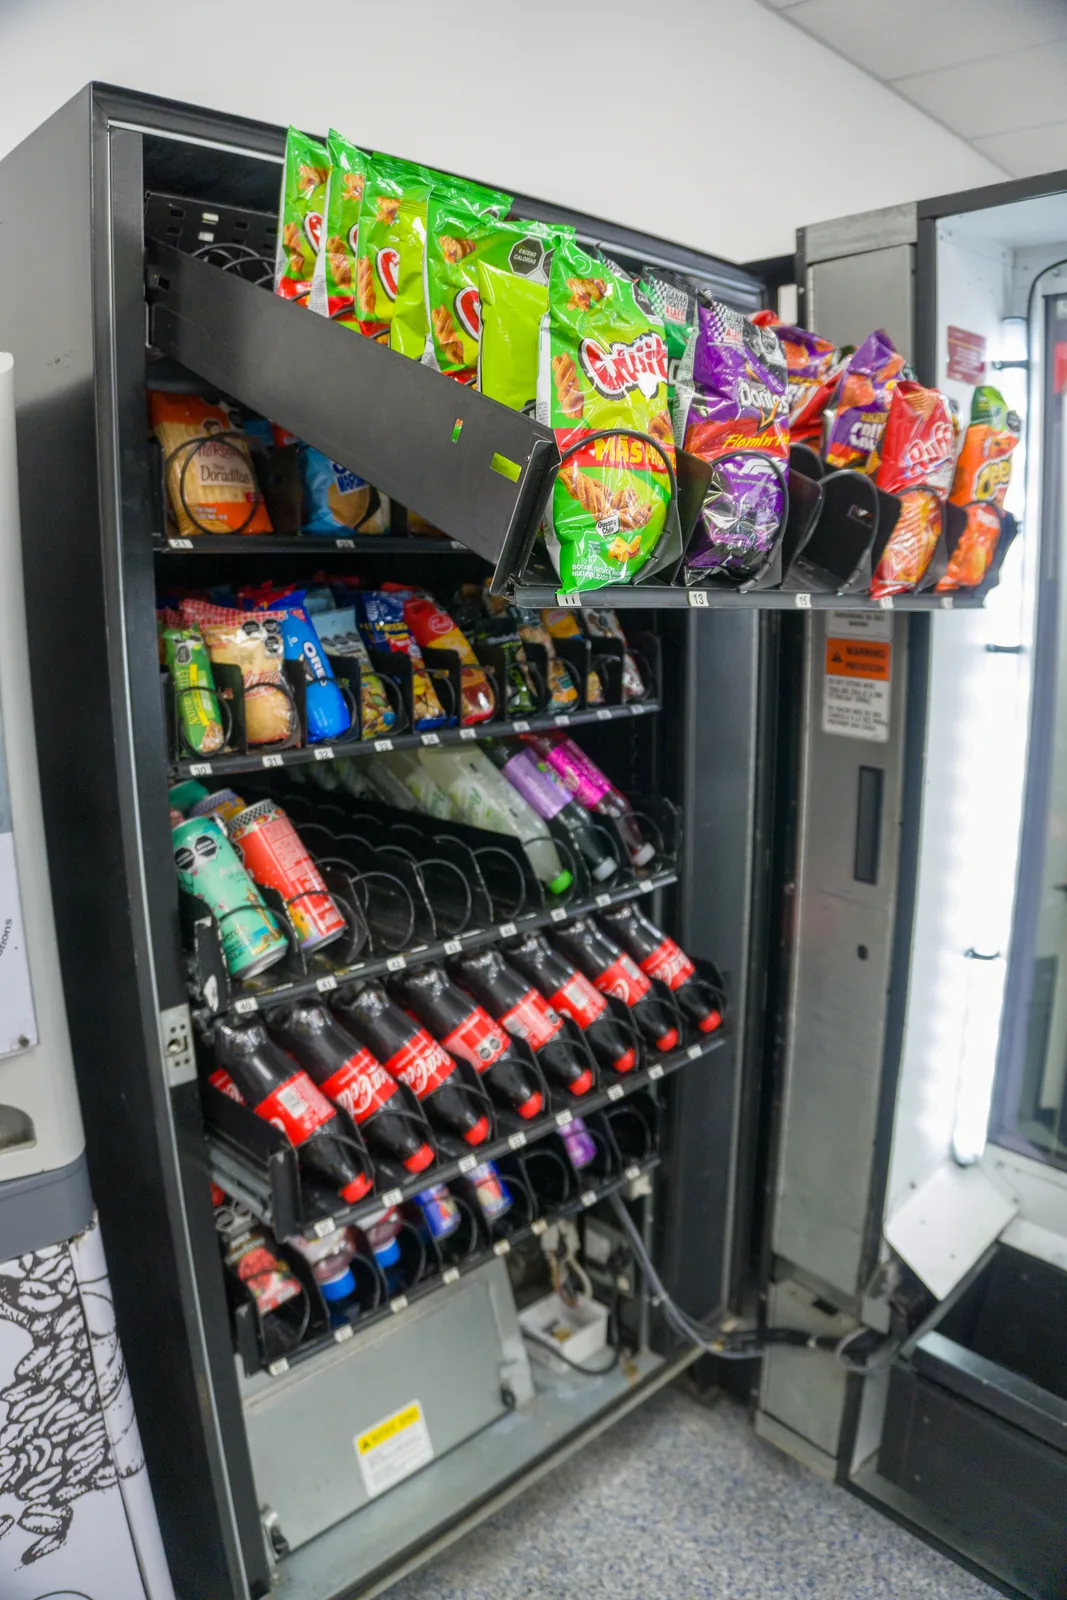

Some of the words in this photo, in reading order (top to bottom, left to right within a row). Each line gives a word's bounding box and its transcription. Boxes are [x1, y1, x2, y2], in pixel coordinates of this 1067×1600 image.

[518, 248, 537, 258] EXCESO
[693, 593, 704, 605] 13
[303, 641, 327, 687] OREO
